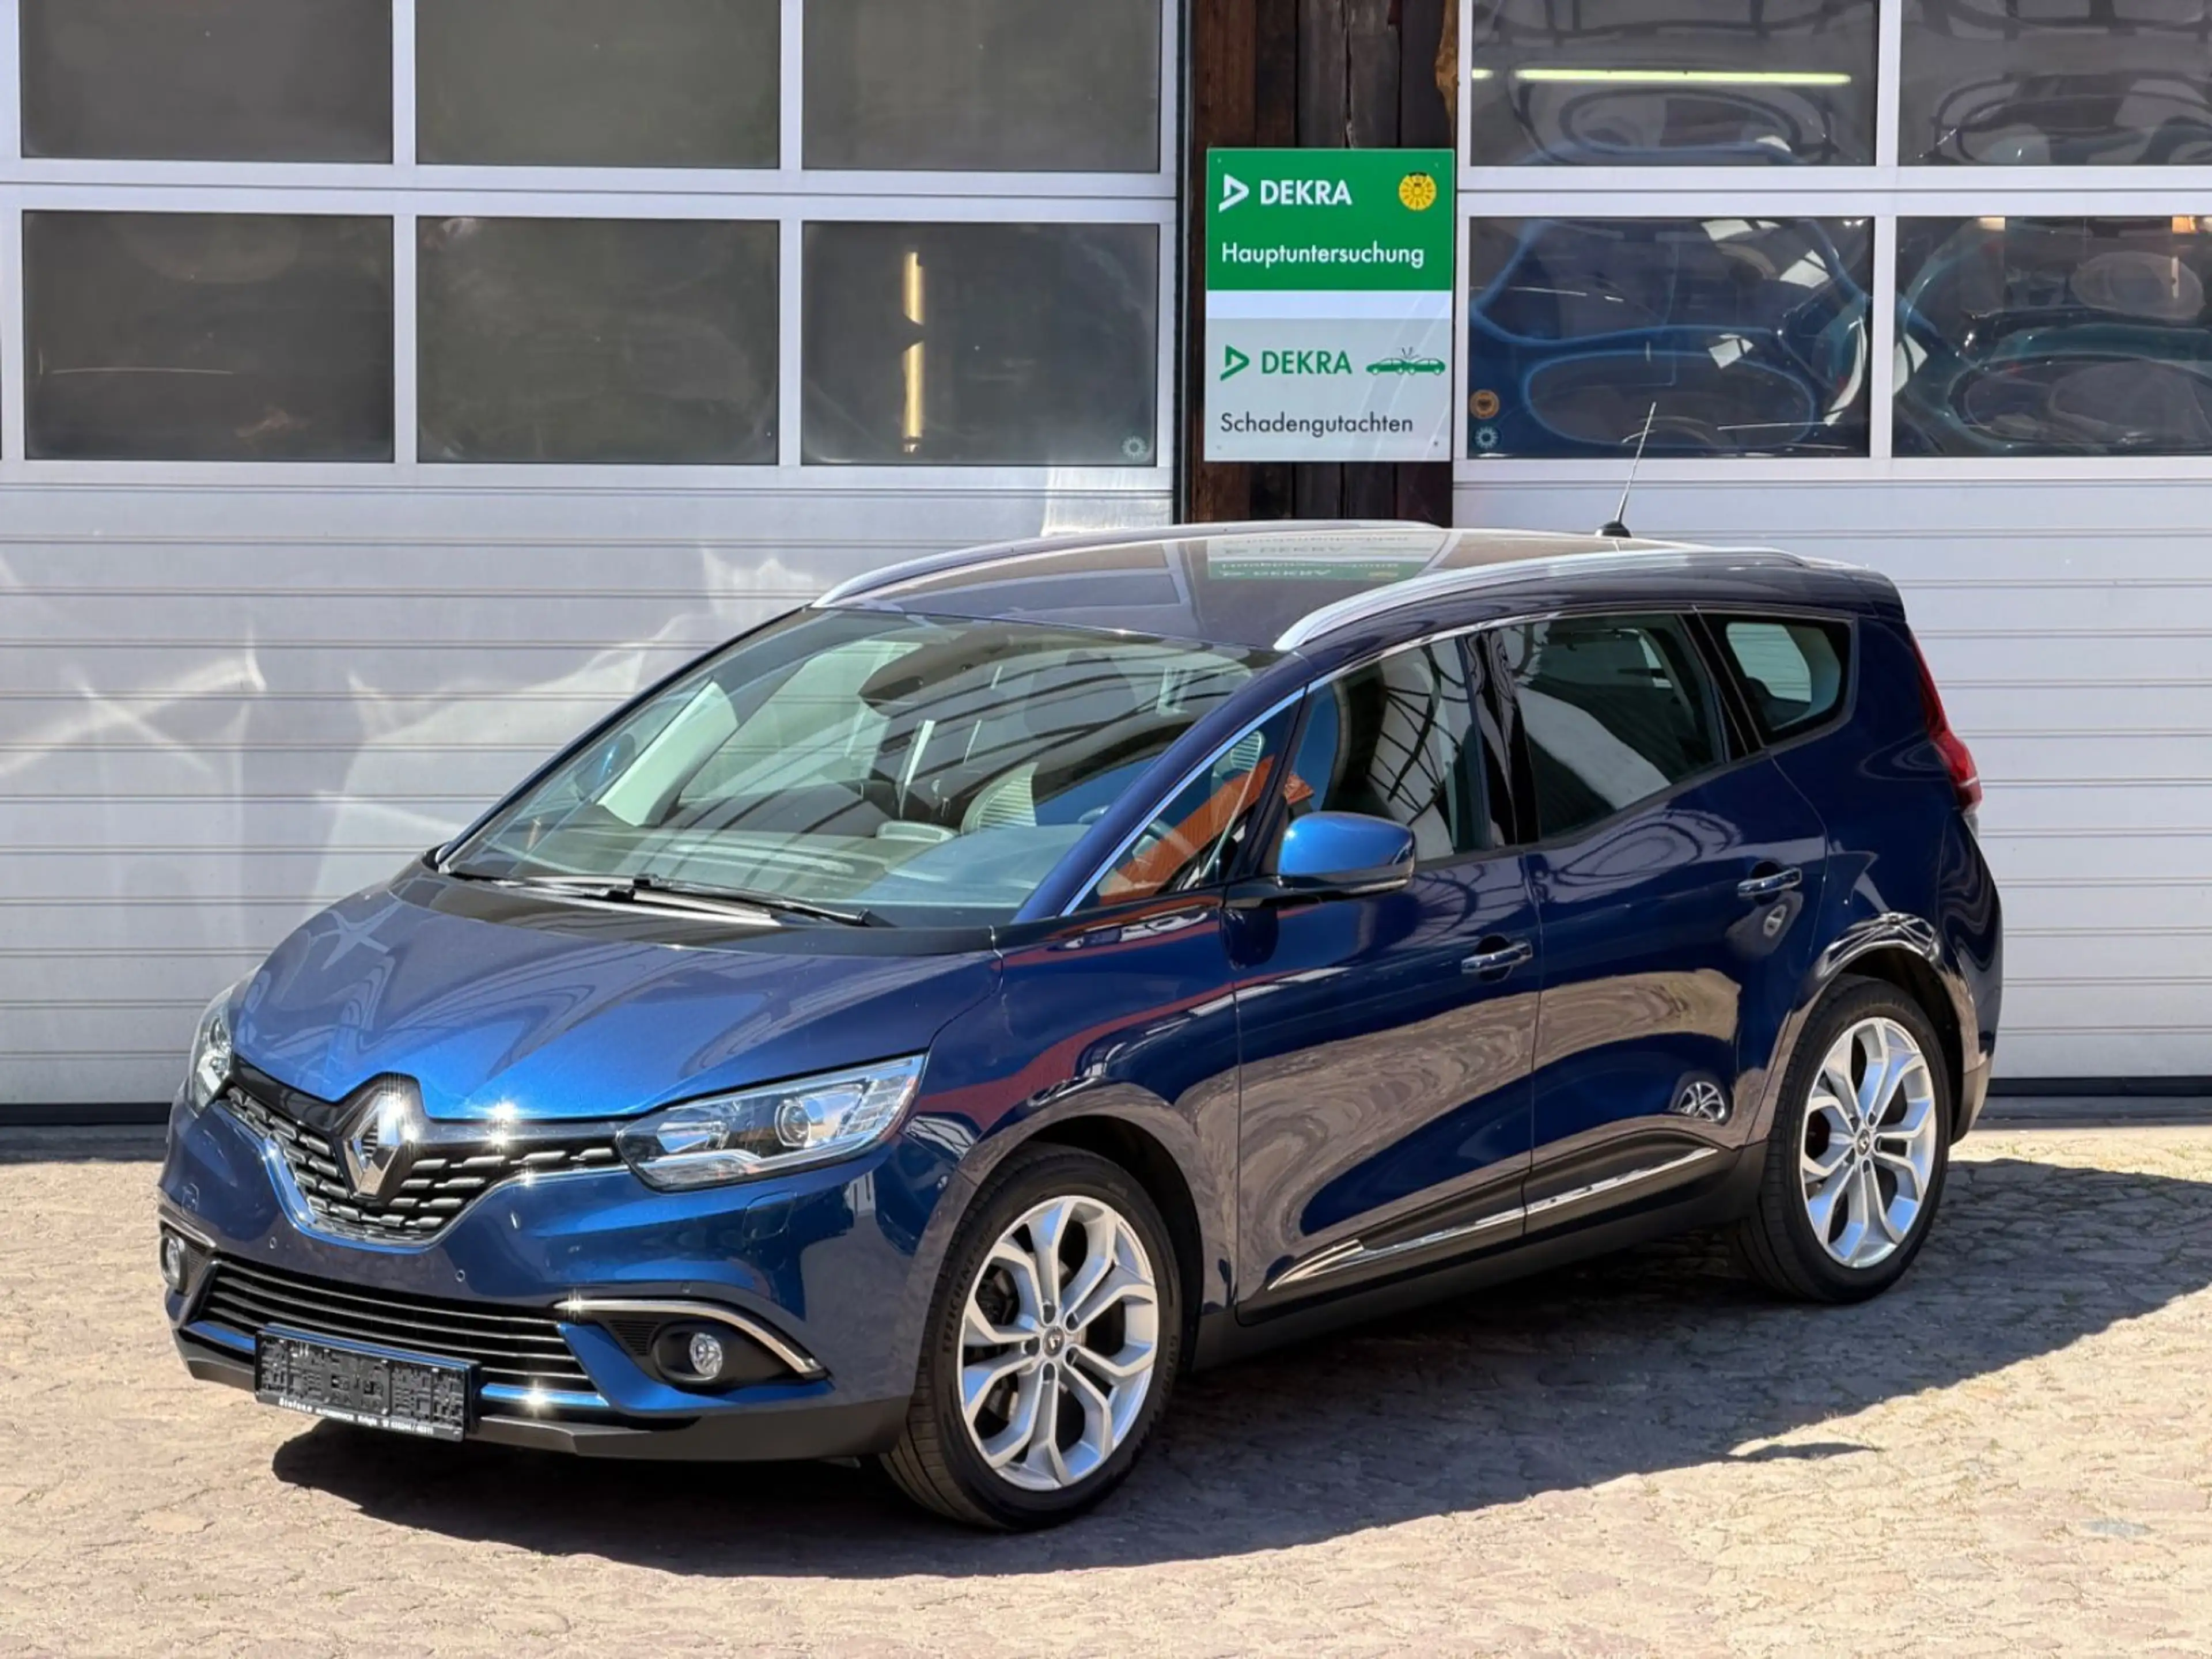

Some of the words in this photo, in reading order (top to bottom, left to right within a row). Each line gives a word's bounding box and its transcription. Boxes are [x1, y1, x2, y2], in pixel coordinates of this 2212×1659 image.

[1260, 179, 1353, 205] DEKRA
[1221, 240, 1425, 268] Hauptuntersuchung
[1262, 350, 1353, 375] DEKRA
[1220, 410, 1413, 438] Schadengutachten
